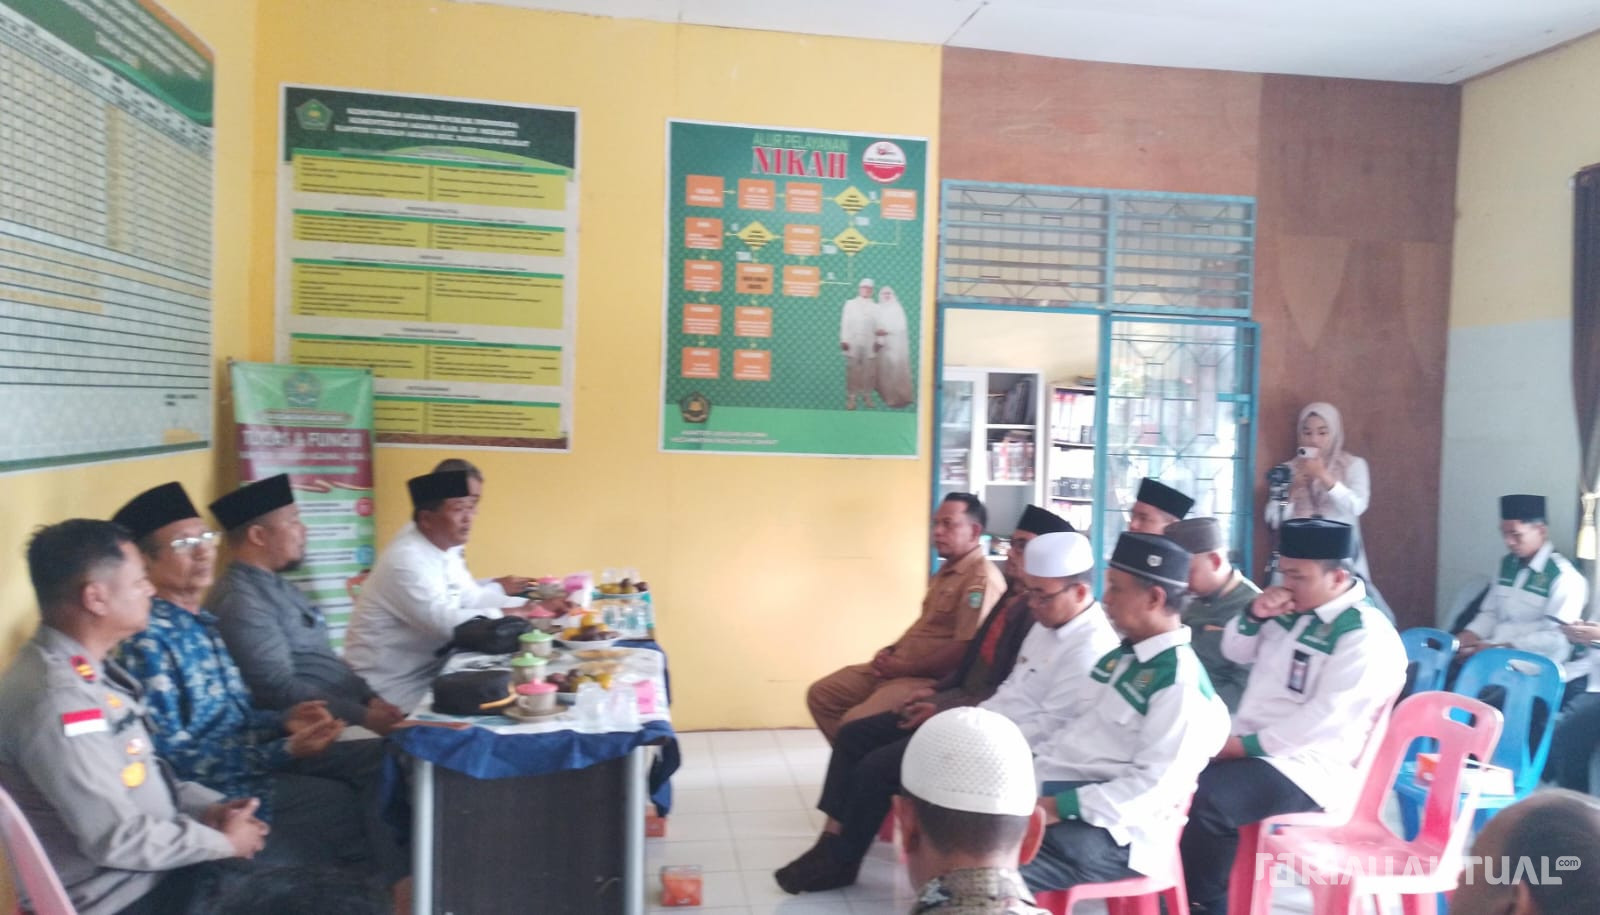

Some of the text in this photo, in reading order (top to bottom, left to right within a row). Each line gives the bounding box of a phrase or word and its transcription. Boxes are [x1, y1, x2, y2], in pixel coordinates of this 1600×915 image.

[752, 132, 849, 152] ALUR PELAYANAN
[752, 146, 849, 179] NIKAH
